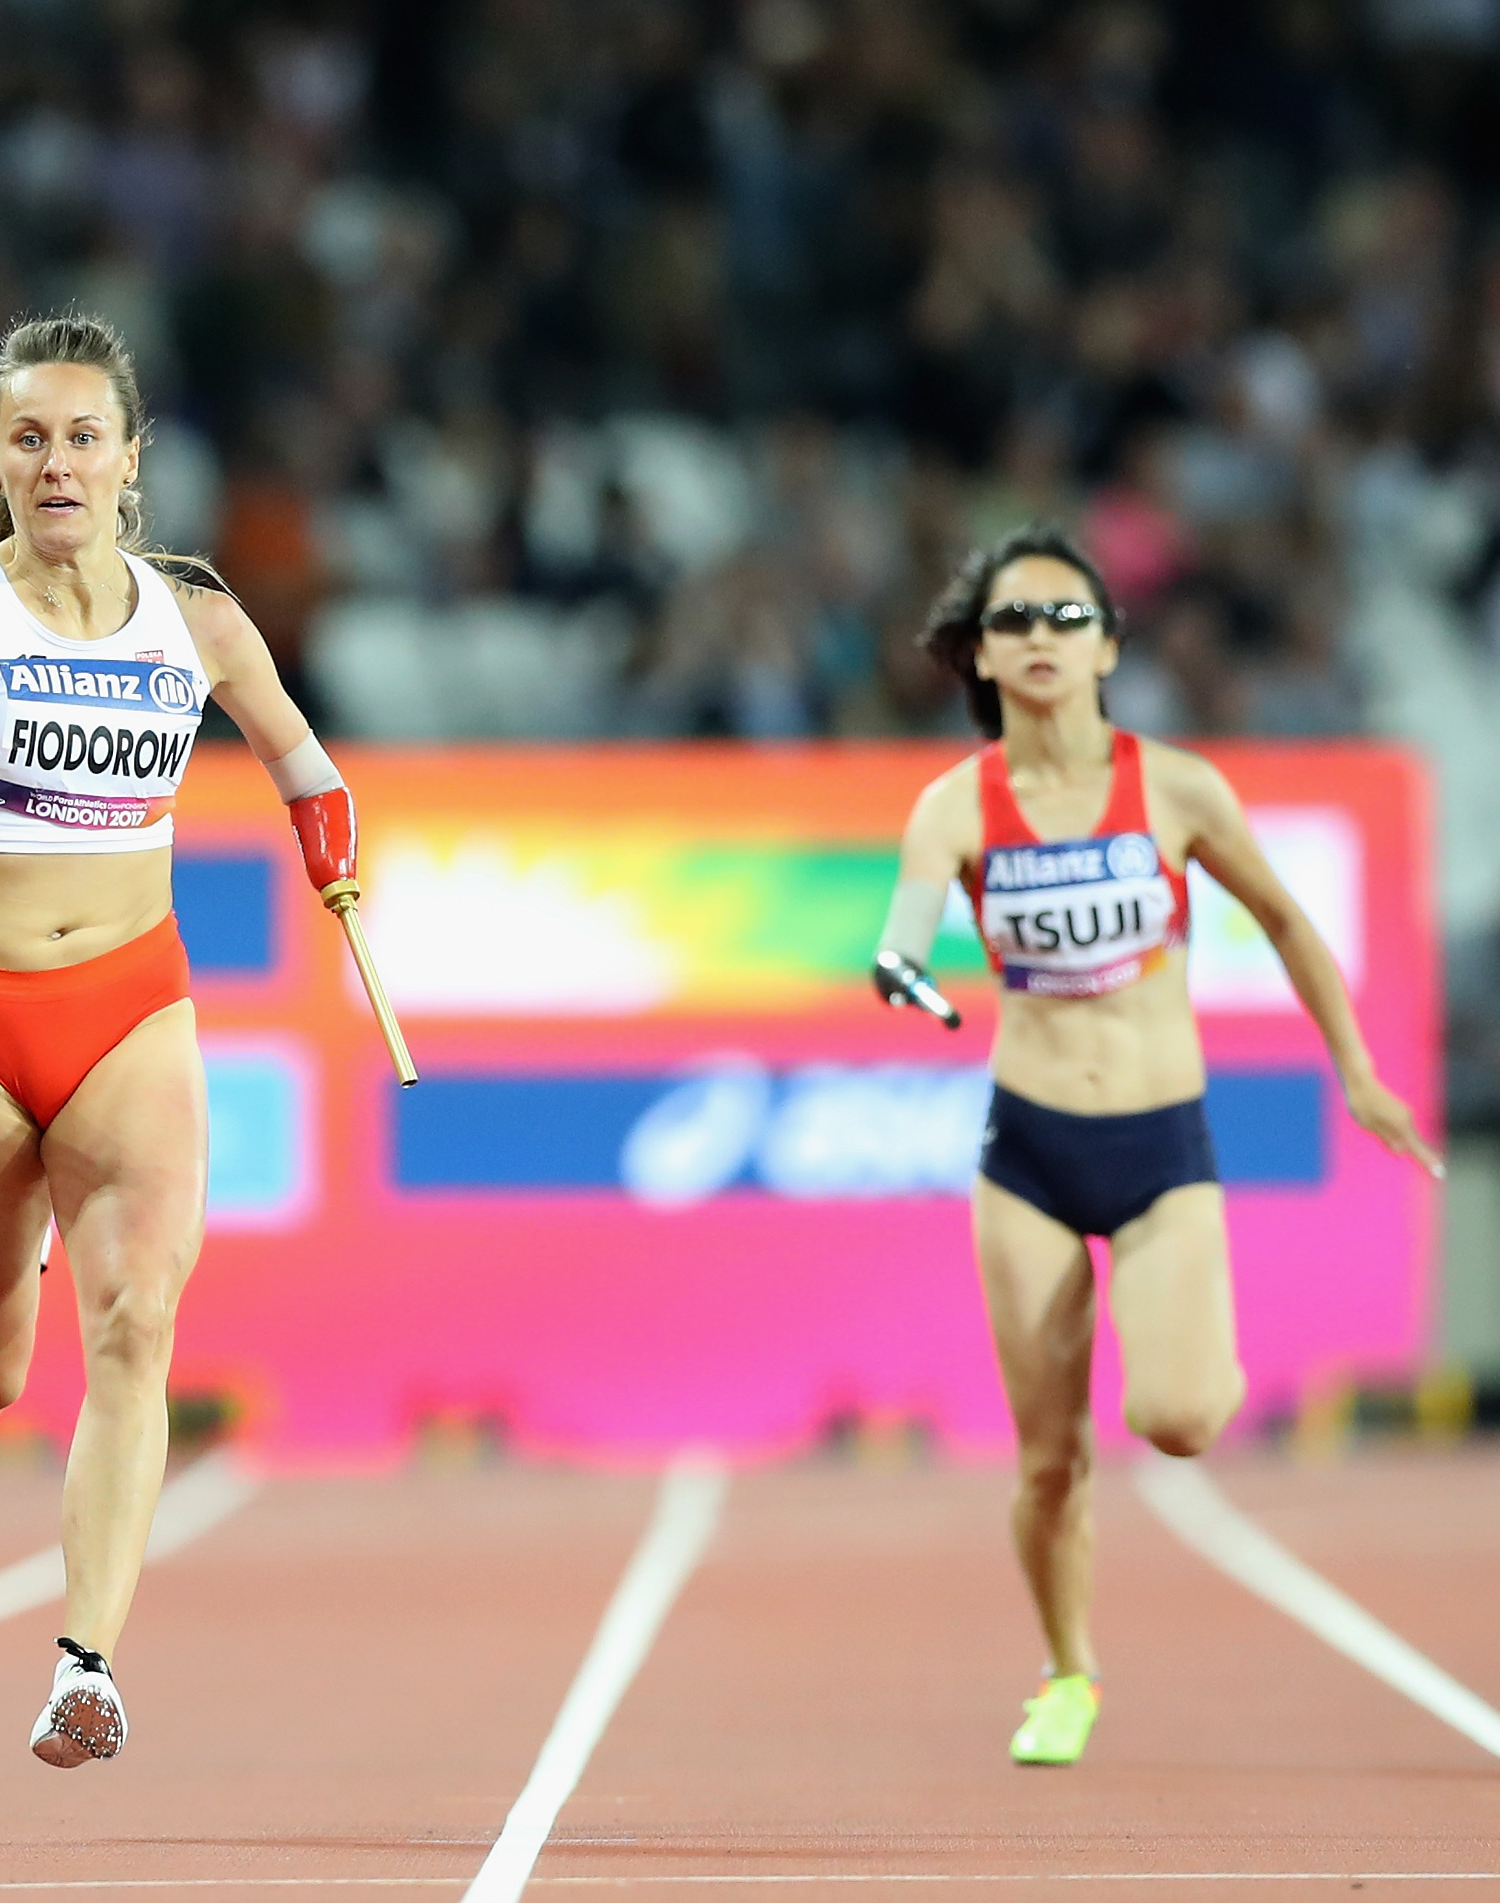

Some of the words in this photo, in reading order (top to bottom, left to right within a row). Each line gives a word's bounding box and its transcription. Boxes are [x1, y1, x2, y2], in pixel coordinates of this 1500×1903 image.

[10, 664, 142, 700] Allianz
[8, 719, 190, 779] FIODOROW
[26, 799, 109, 827] LONDON
[108, 810, 146, 827] 2017
[53, 795, 74, 806] Para
[73, 797, 107, 810] Athletics
[986, 849, 1105, 887] Allianz
[1007, 901, 1141, 950] TSUJI
